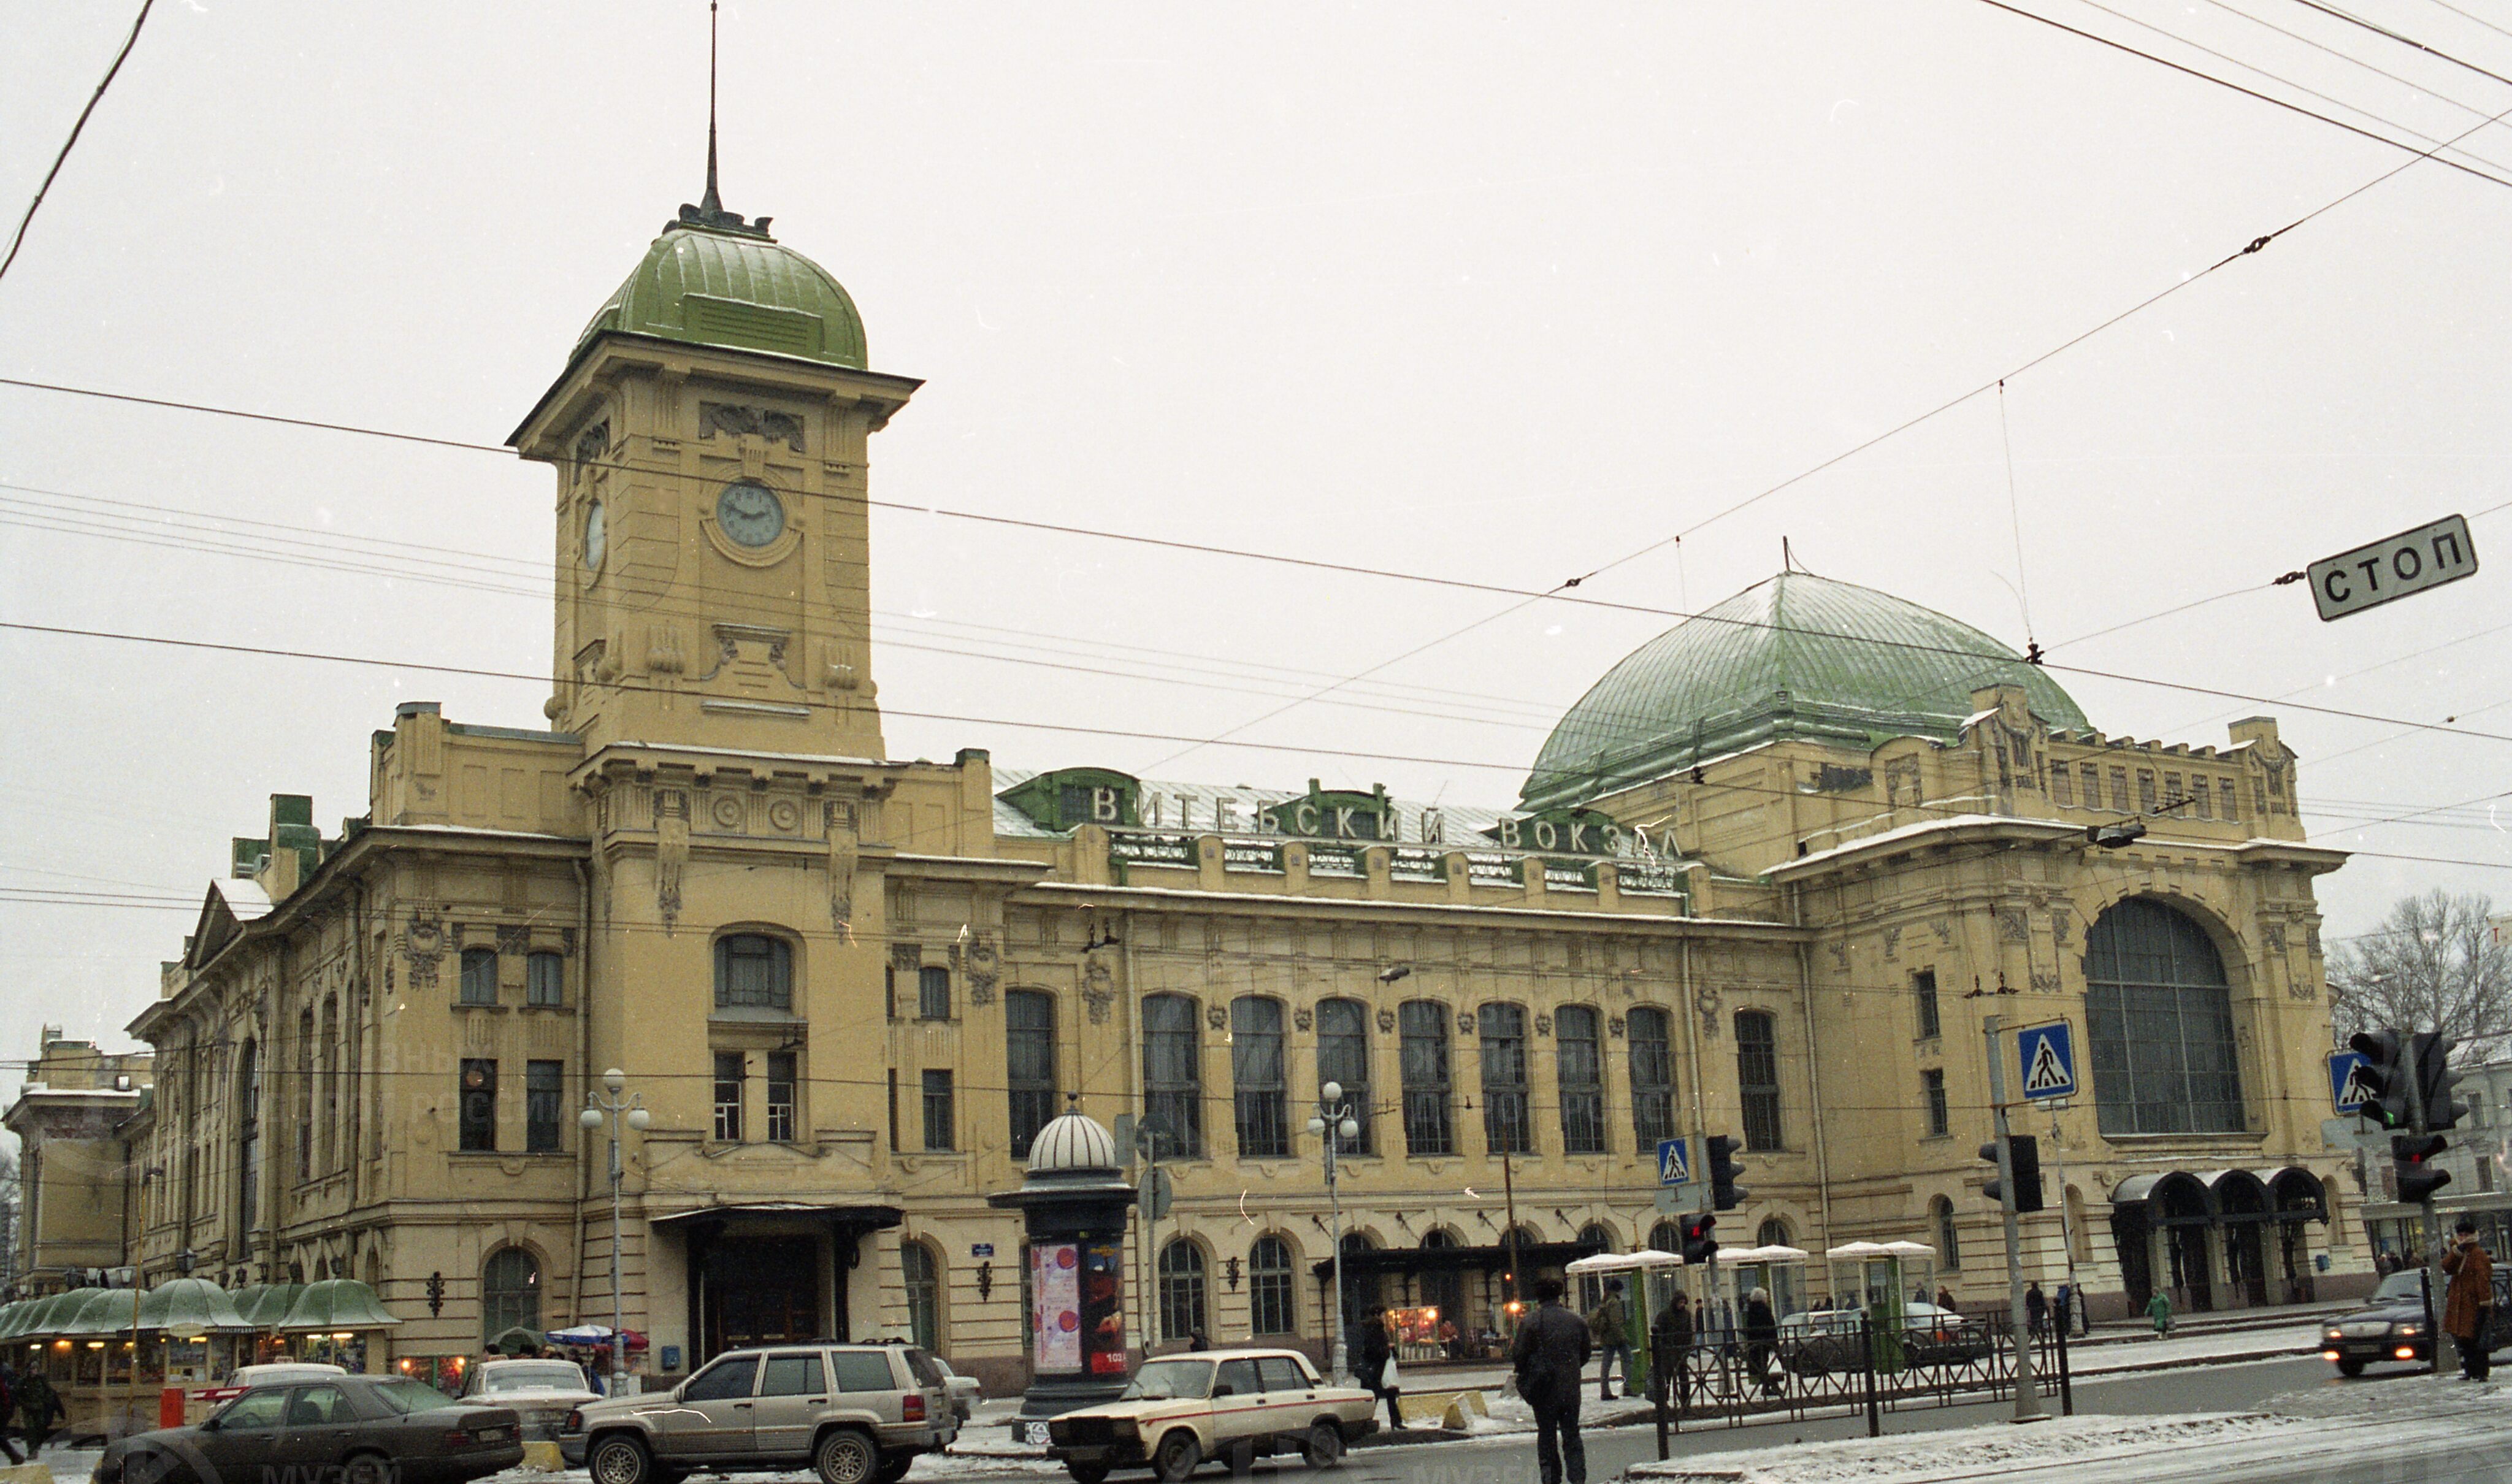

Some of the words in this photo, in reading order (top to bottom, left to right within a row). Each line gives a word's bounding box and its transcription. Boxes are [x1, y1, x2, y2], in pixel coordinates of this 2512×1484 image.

[2324, 531, 2462, 603] СТОП
[1093, 786, 1446, 844] ВИТЕБСКИЙ
[1498, 817, 1682, 857] ВОКЗАЛ
